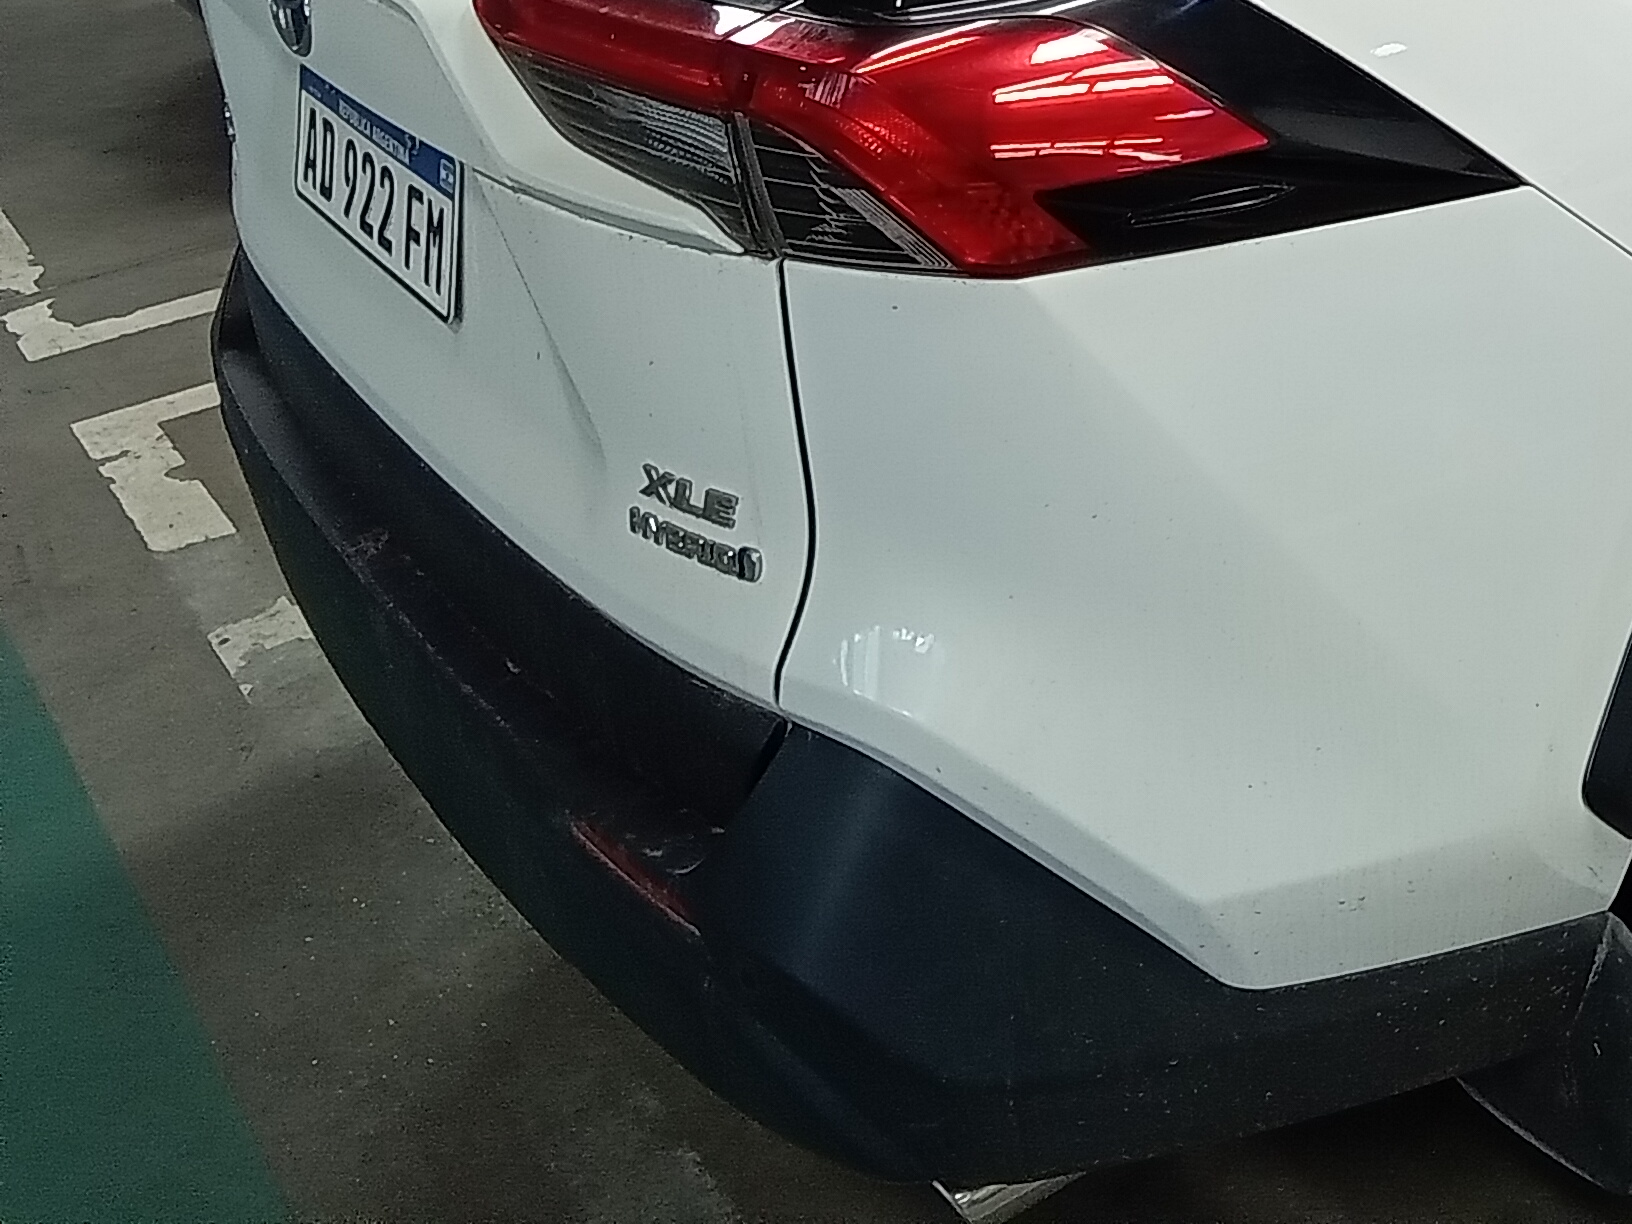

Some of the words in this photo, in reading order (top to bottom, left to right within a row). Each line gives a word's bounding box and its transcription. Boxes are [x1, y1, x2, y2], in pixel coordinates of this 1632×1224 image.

[303, 106, 336, 203] AD
[343, 138, 395, 257] 922
[404, 183, 445, 297] FM
[638, 462, 740, 530] XLE
[628, 505, 763, 584] HYBRID
